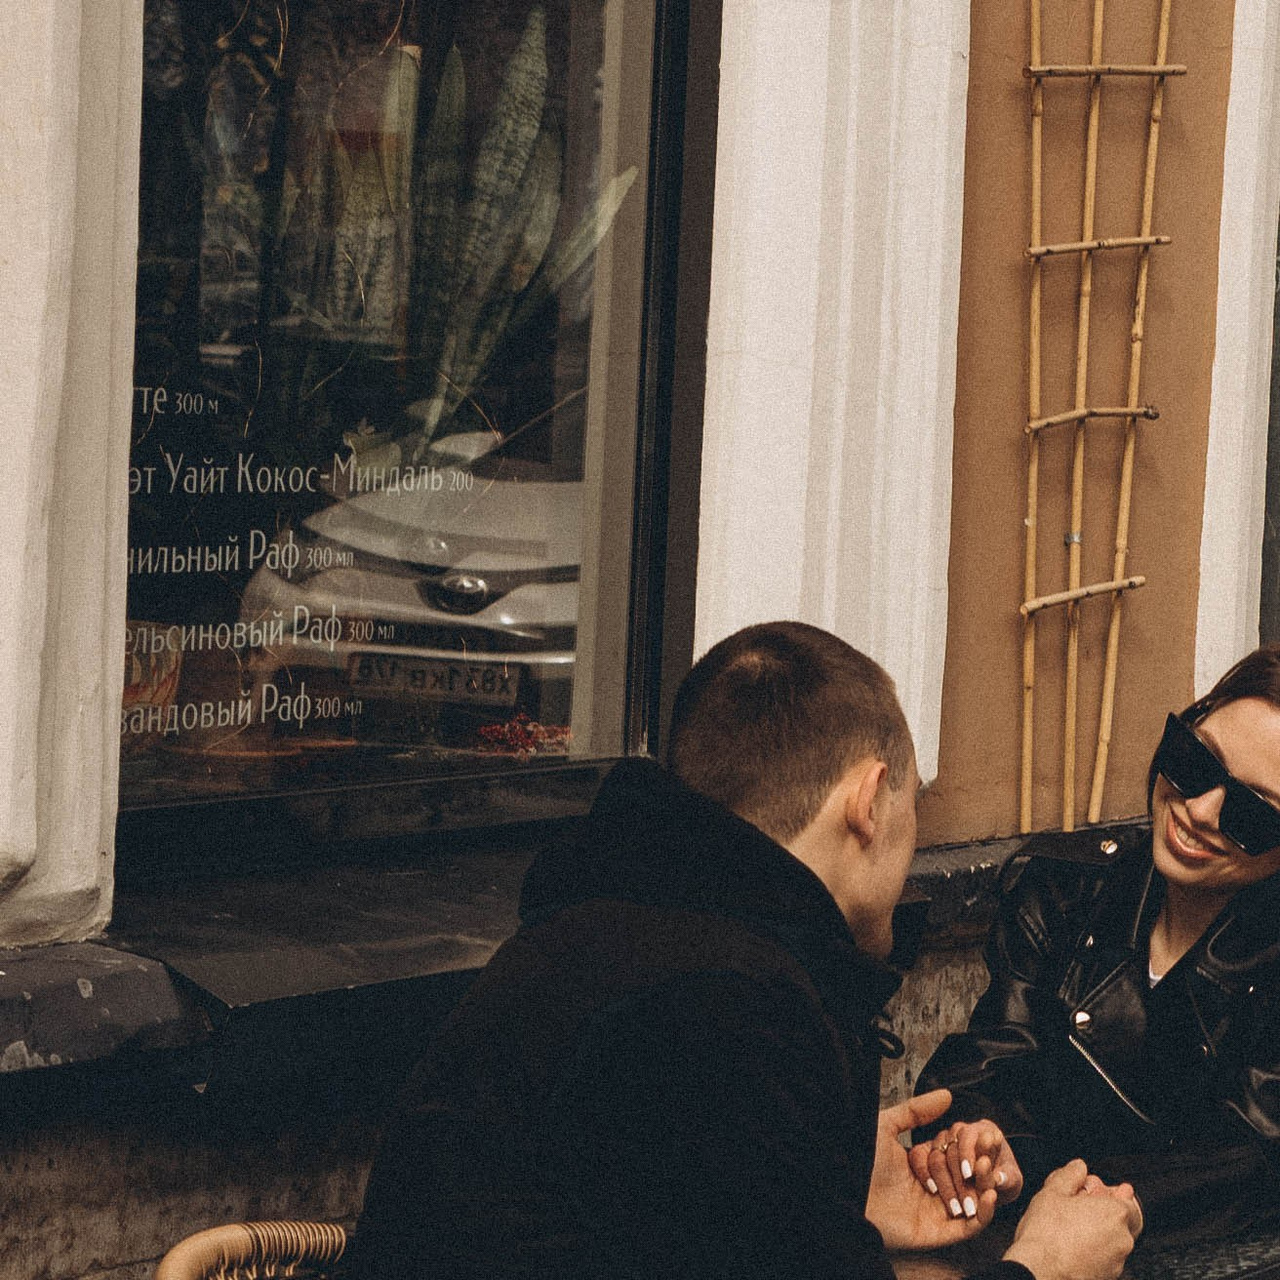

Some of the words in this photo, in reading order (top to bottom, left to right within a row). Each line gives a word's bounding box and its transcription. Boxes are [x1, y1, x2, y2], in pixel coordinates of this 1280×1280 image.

[174, 392, 204, 415] 300
[165, 453, 229, 494] Уайт
[236, 452, 444, 497] Кокос-Миндаль
[449, 470, 474, 492] 200
[249, 530, 300, 579] Раф
[305, 546, 332, 569] 300
[335, 549, 355, 567] мл
[292, 604, 342, 652] Раф
[348, 620, 374, 641] 300
[377, 624, 395, 640] мл
[261, 682, 311, 730] Раф
[314, 696, 341, 719] 300
[344, 700, 363, 716] мл
